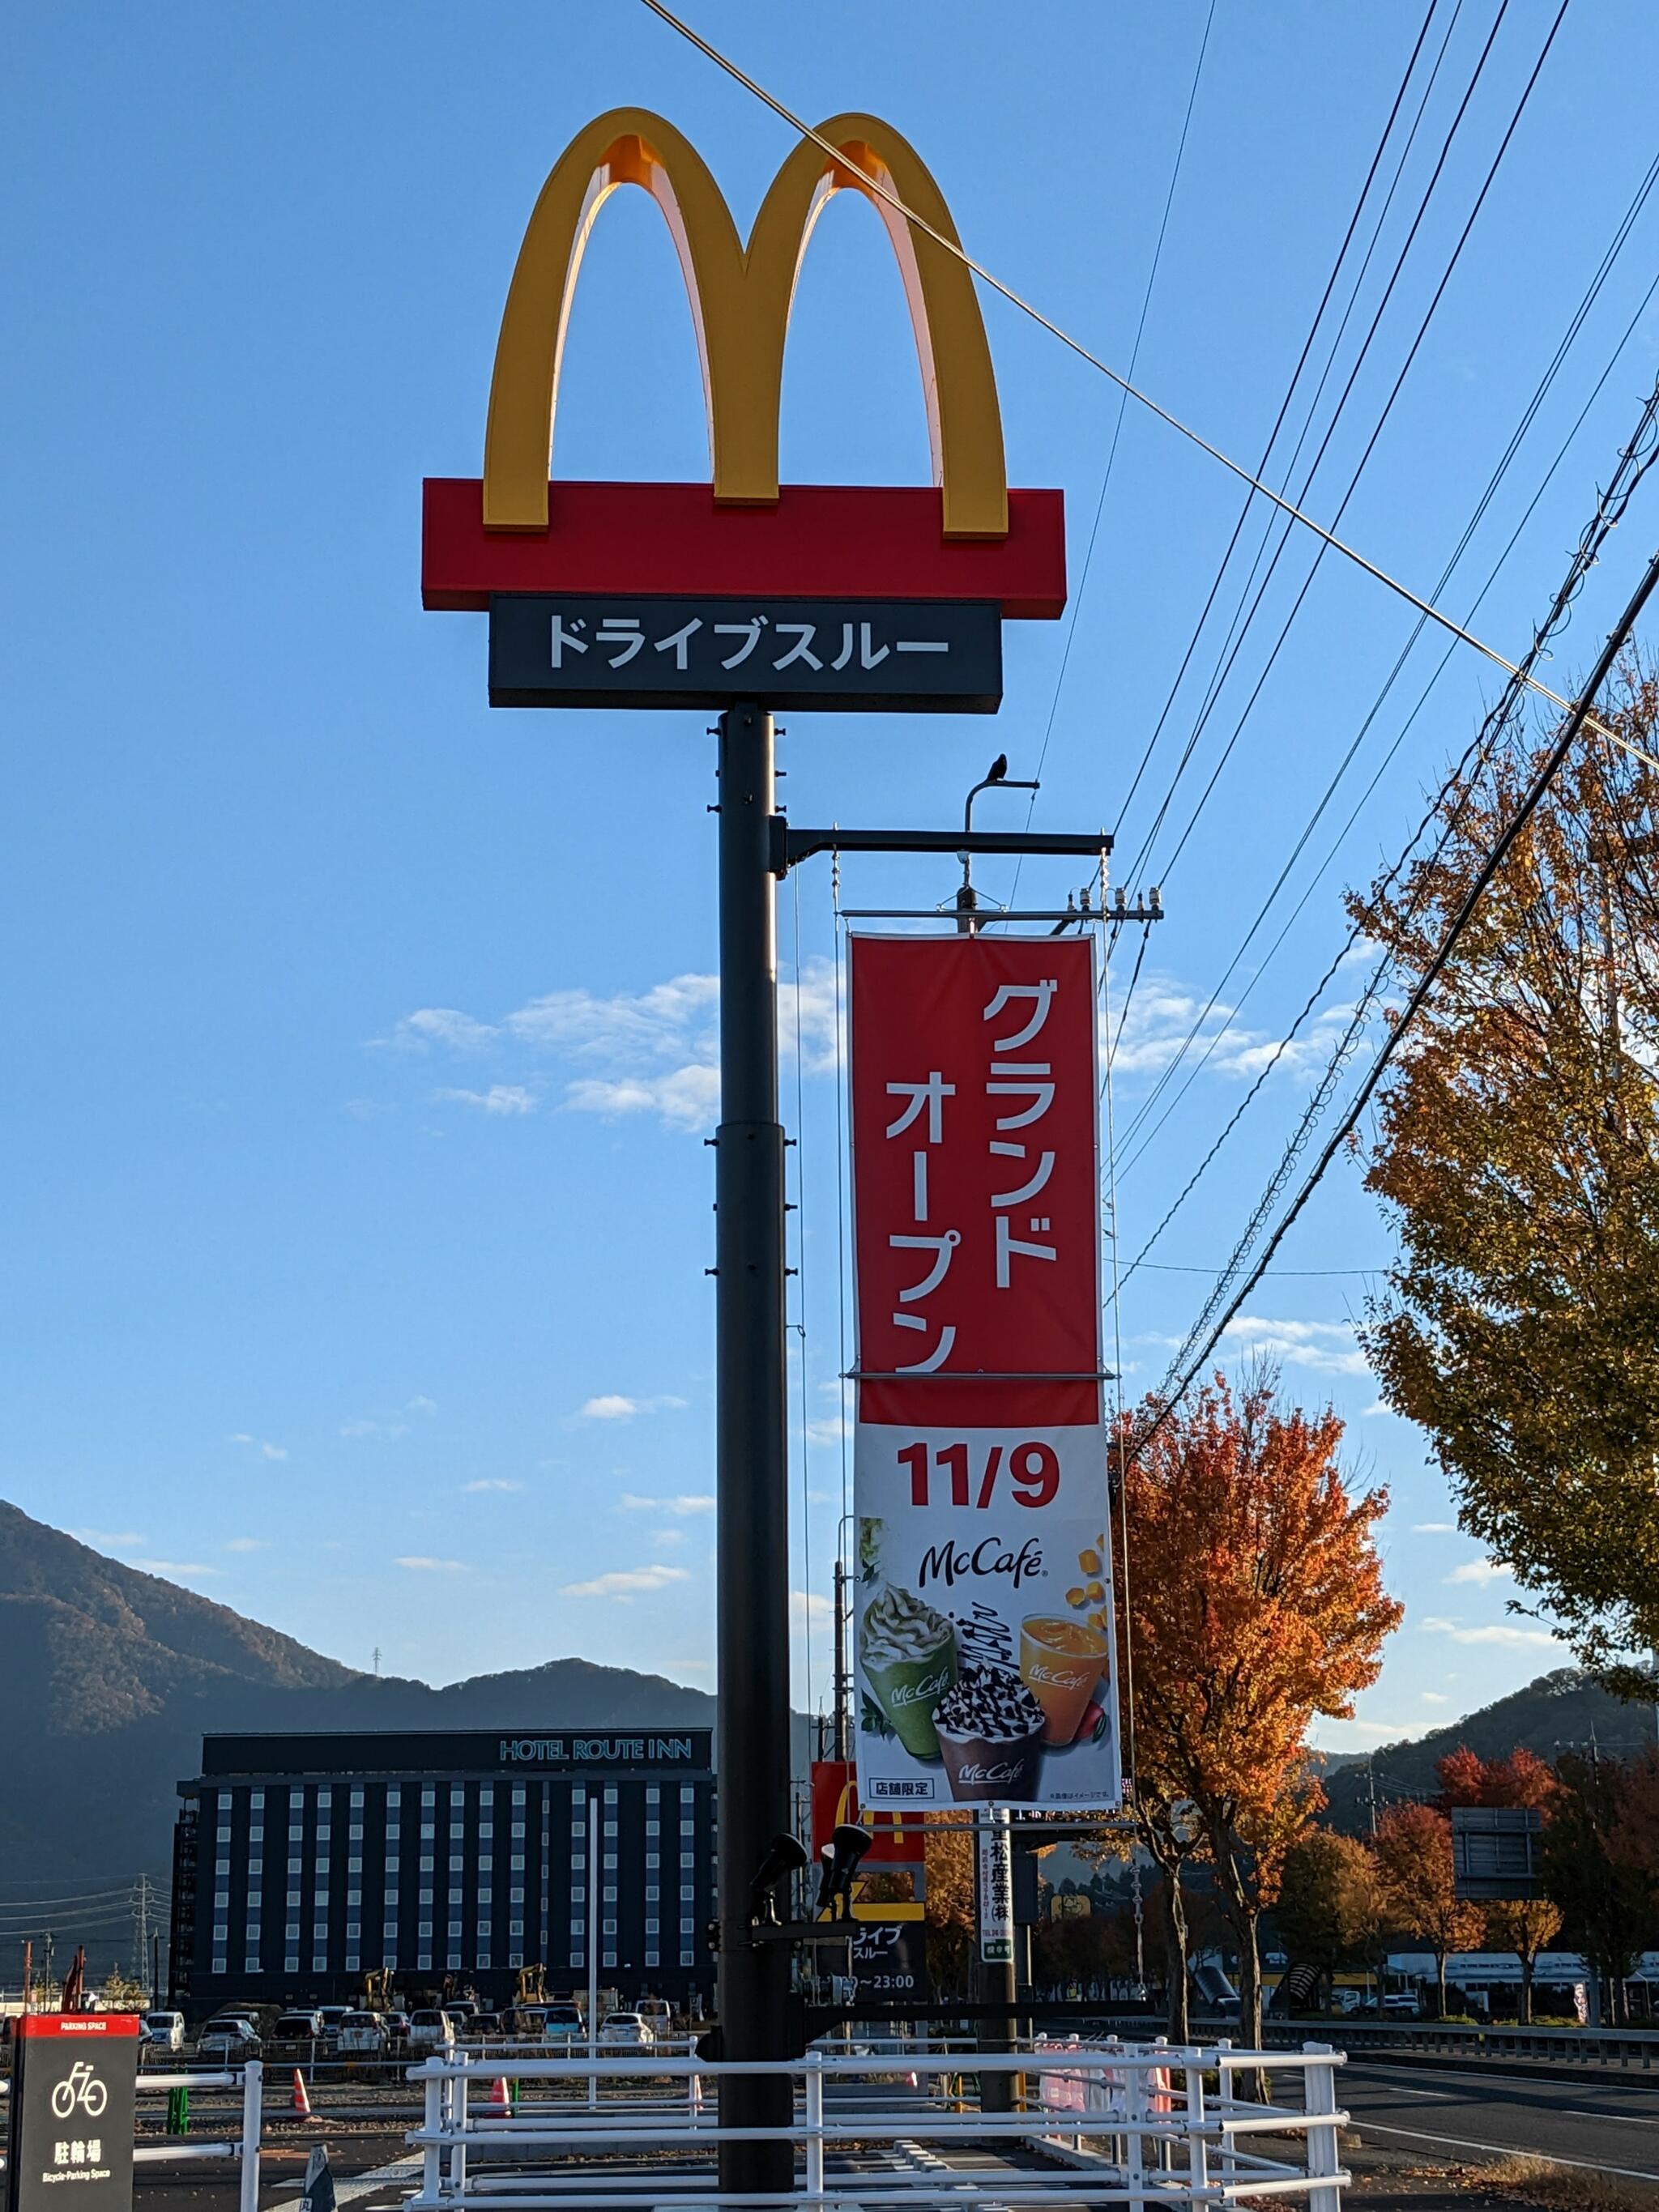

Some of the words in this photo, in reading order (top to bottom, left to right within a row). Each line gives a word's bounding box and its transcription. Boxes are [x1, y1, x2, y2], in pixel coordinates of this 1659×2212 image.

[551, 614, 949, 671] ドライブスルー
[983, 978, 1058, 1289] グランド
[885, 1071, 962, 1373] オープン
[897, 1441, 1060, 1509] 11/9
[500, 1740, 569, 1761] HOTEL
[573, 1739, 644, 1759] ROUTE
[647, 1738, 692, 1759] INN
[875, 1782, 928, 1796] 店舗限定
[853, 1946, 888, 1959] スルー
[87, 2022, 106, 2031] SPACE
[54, 2139, 101, 2165] 駐輪場
[91, 2168, 111, 2180] Space
